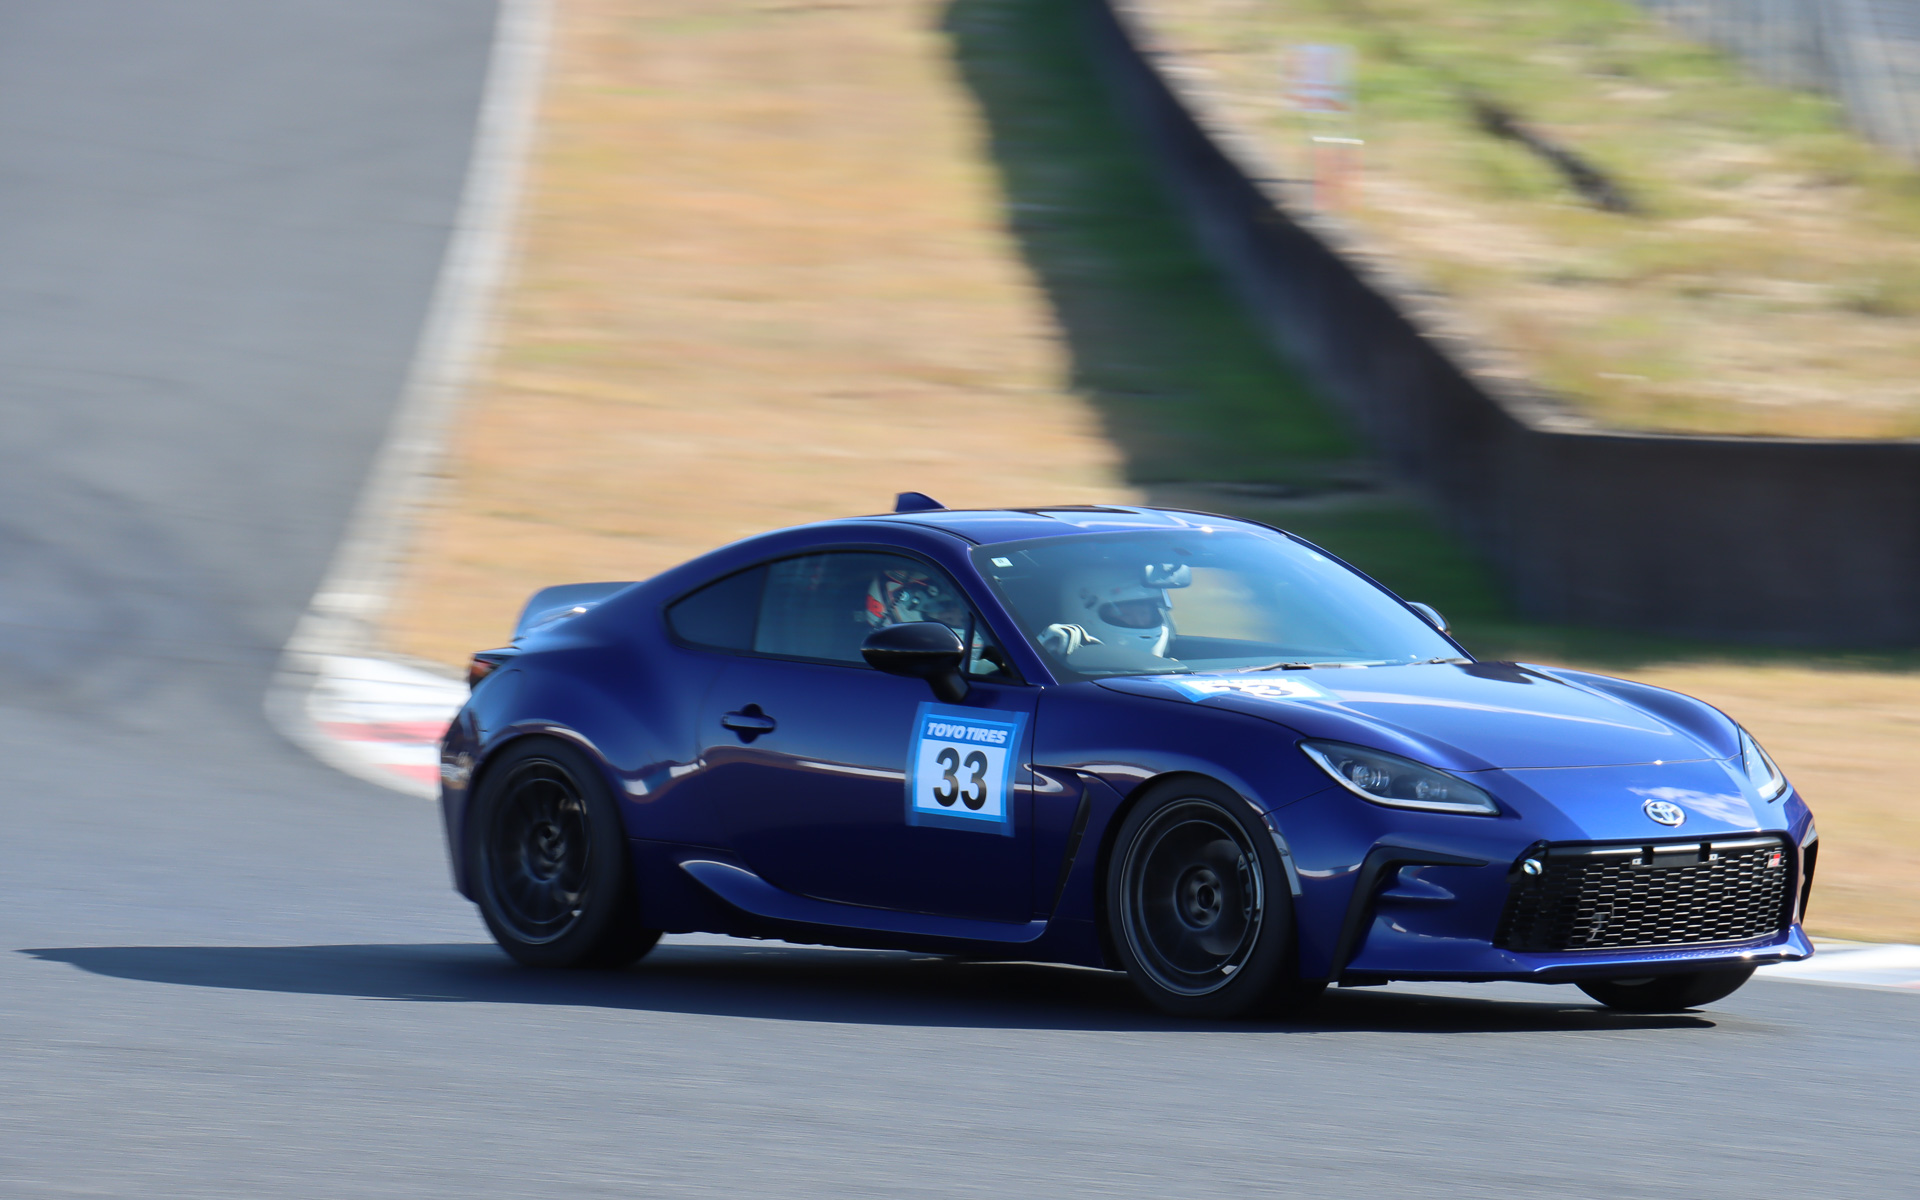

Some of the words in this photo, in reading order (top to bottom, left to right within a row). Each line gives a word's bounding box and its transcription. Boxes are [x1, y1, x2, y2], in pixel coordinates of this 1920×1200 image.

[926, 722, 966, 739] TOYO
[966, 727, 1008, 744] TIRES
[933, 747, 988, 810] 33
